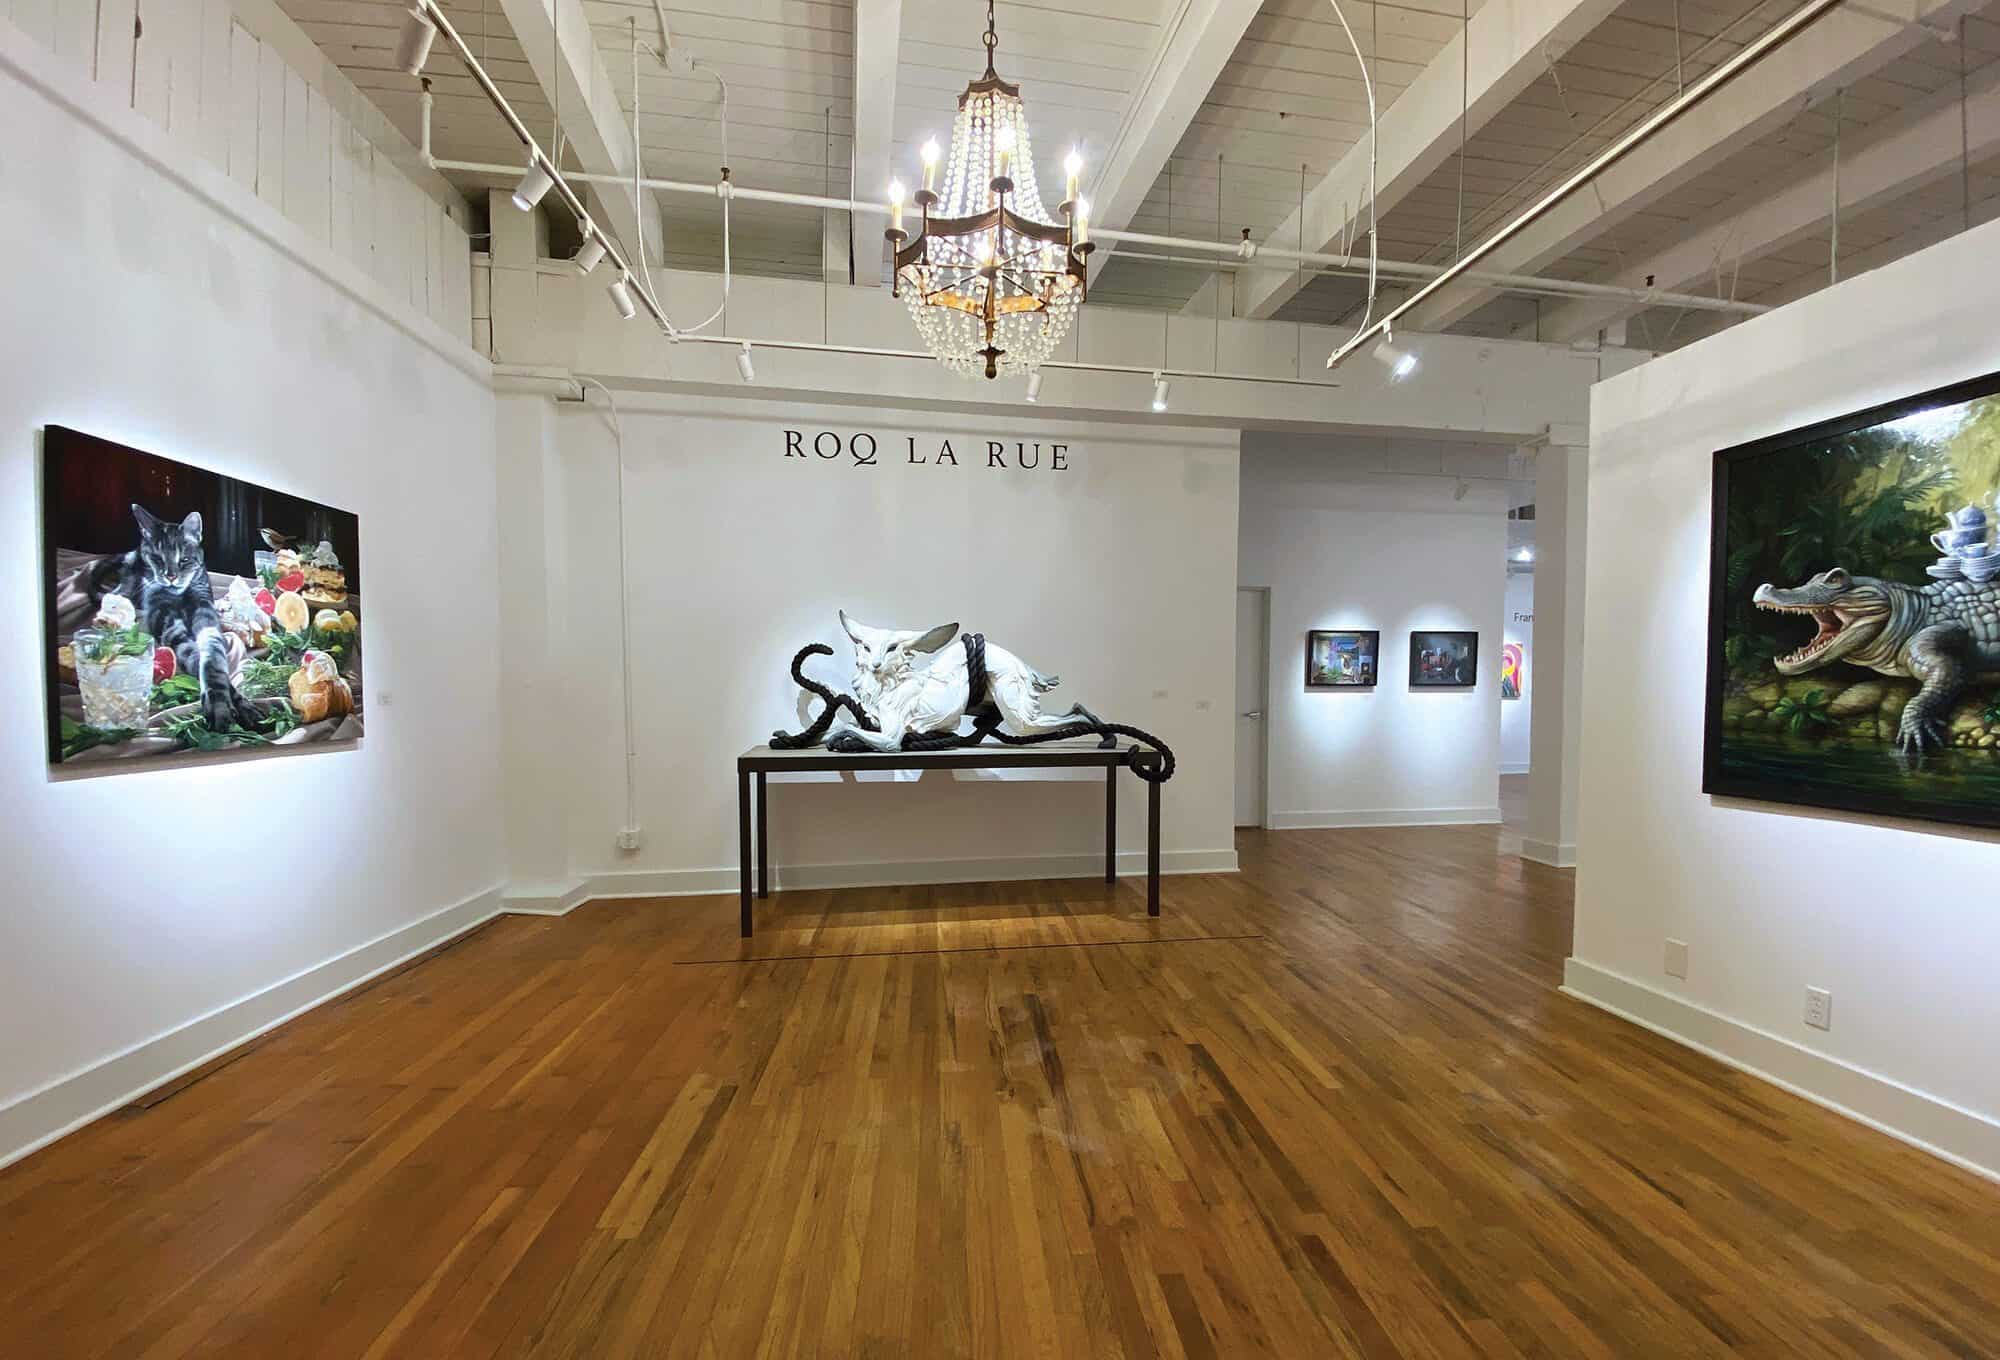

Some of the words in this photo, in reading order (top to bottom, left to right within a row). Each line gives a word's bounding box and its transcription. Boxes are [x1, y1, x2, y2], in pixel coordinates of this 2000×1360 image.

[784, 430, 877, 466] ROQ
[907, 437, 958, 465] LA
[986, 441, 1068, 470] RUE
